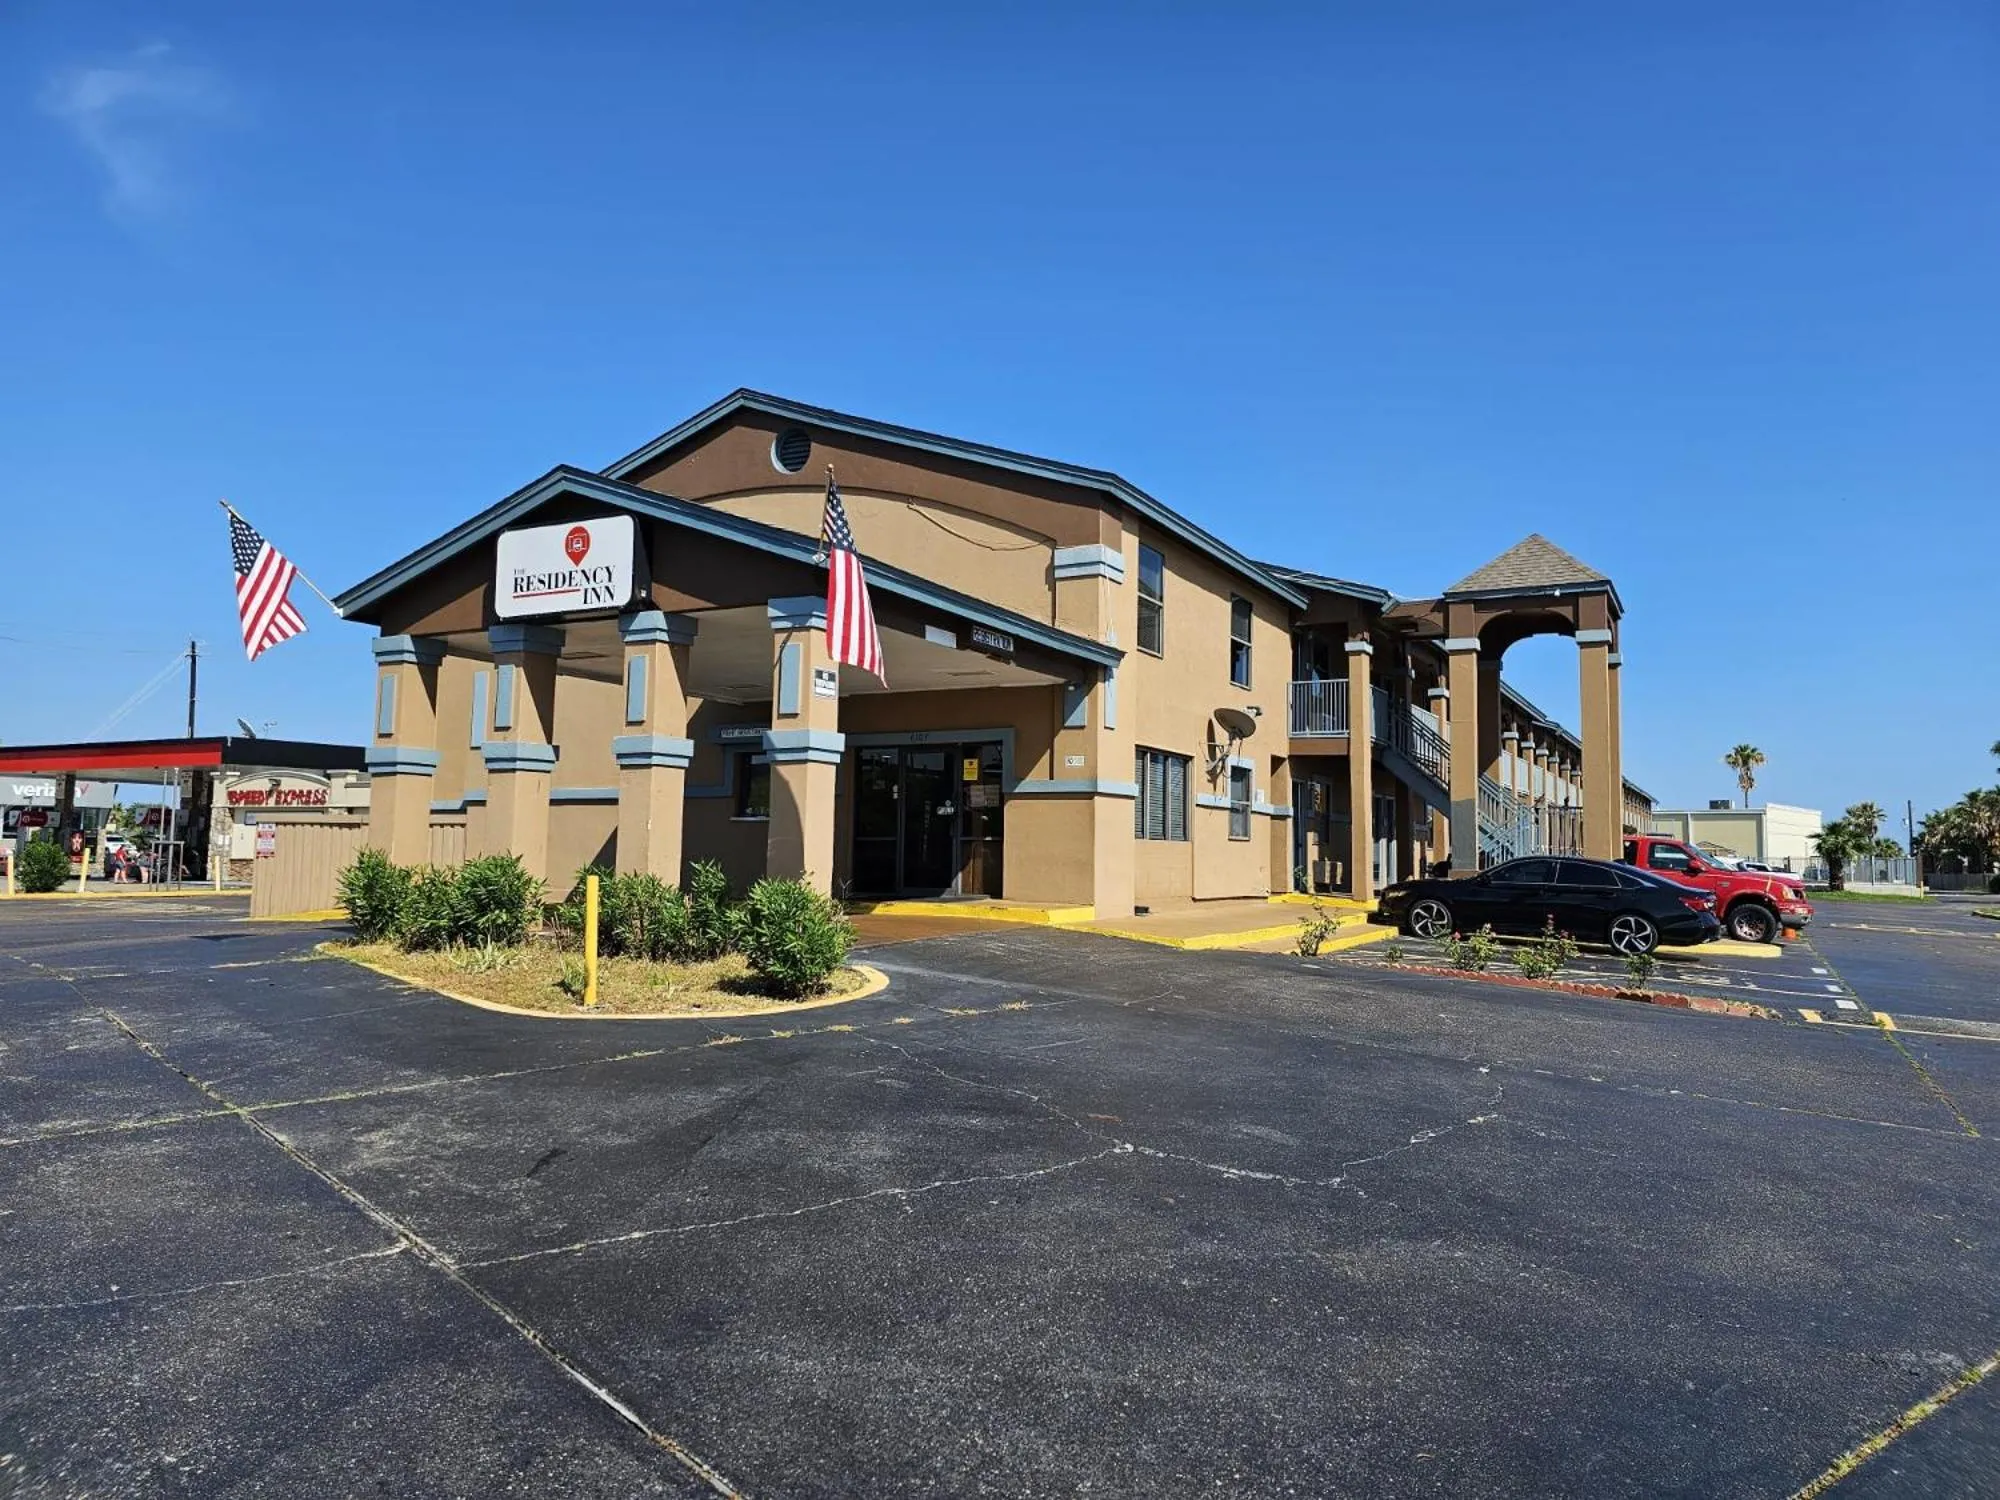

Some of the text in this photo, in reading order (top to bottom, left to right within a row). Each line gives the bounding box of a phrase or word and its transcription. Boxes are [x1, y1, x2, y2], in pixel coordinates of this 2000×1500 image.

[513, 565, 616, 593] RESIDENCY
[583, 585, 616, 605] INN
[274, 789, 328, 806] EXPRESS
